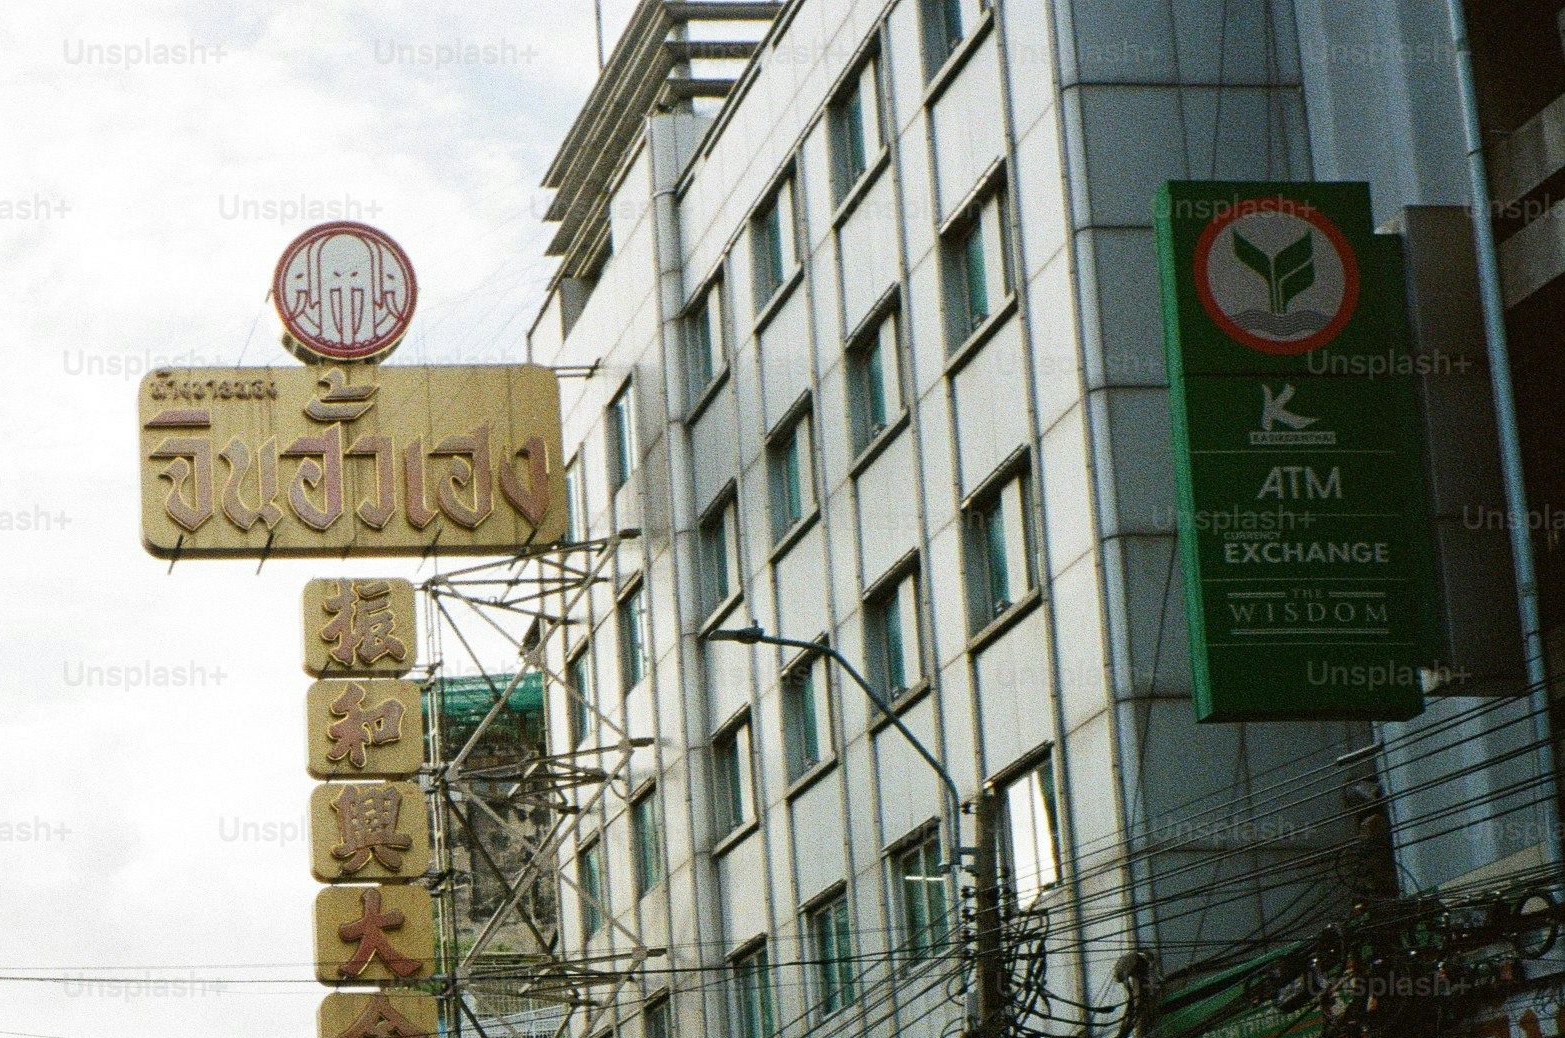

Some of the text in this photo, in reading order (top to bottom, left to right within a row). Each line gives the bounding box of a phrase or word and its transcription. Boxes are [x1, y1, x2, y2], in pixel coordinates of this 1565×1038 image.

[1255, 465, 1343, 500] ATM
[1223, 530, 1281, 541] CURRENCY
[1223, 541, 1390, 564] EXCHANGE
[1293, 588, 1324, 599] THE
[1228, 602, 1389, 623] WISDOM
